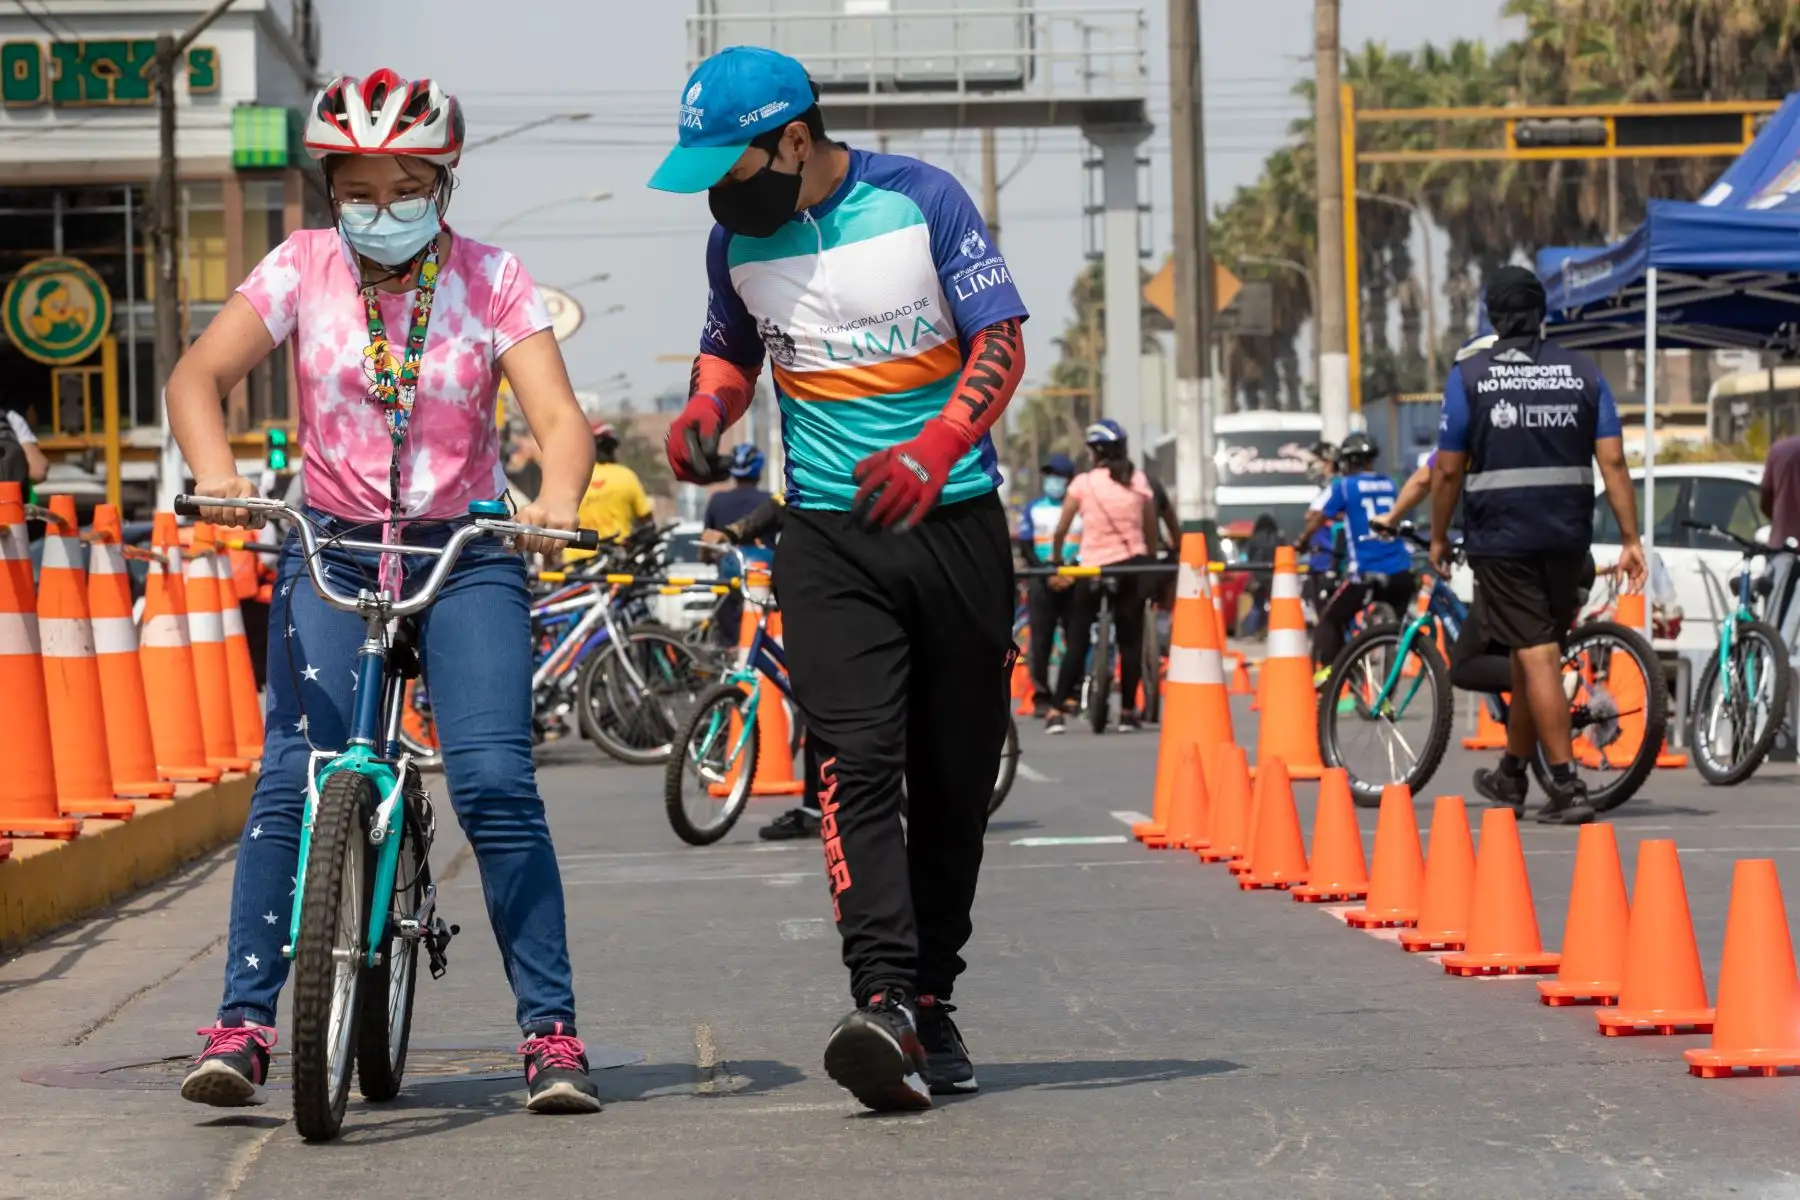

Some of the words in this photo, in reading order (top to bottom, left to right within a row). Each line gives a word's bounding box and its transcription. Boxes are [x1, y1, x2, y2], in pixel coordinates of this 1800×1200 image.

[739, 110, 759, 127] SAT
[955, 267, 1012, 301] LIMA
[820, 305, 912, 334] MUNICIPALIDAD
[914, 297, 930, 311] DE
[822, 315, 941, 361] LIMA
[1488, 364, 1573, 378] TRANSPORTE
[1477, 379, 1499, 393] NO
[1501, 377, 1585, 391] MOTORIZADO
[1525, 410, 1578, 428] LIMA
[817, 756, 852, 898] UNDER
